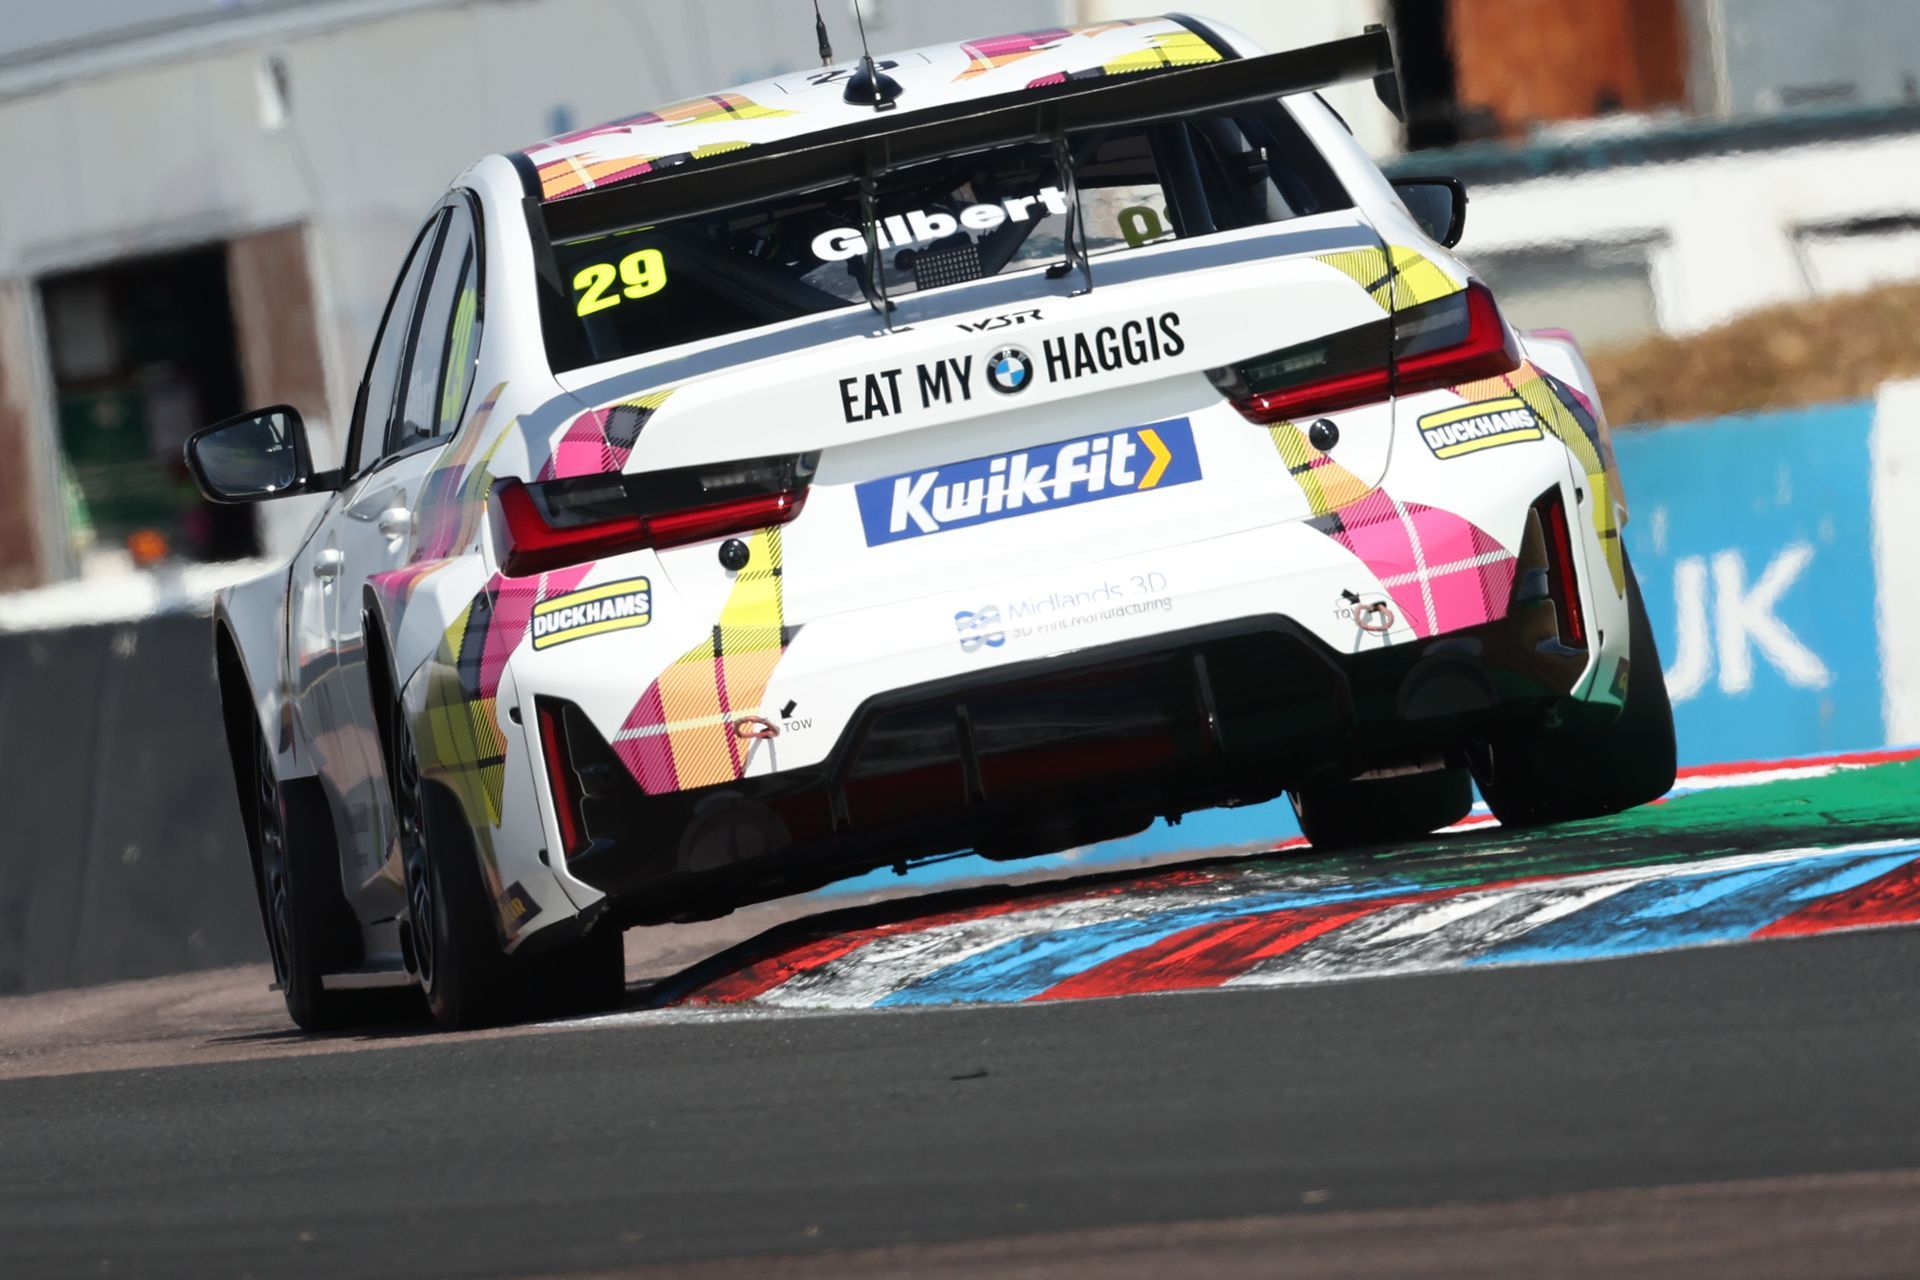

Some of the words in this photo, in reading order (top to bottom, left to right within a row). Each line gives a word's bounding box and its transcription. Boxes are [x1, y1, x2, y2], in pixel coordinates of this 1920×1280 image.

[811, 186, 1068, 262] Gilbert
[573, 248, 667, 317] 29
[955, 309, 1044, 333] WSR
[839, 368, 902, 423] EAT
[916, 355, 973, 408] MY
[1043, 311, 1185, 383] HAGGIS
[1423, 409, 1536, 449] DUCKHAMS
[534, 593, 650, 637] DUCKHAMS
[1008, 582, 1124, 622] Midlands
[1130, 572, 1168, 595] 3D
[783, 718, 813, 732] TOW
